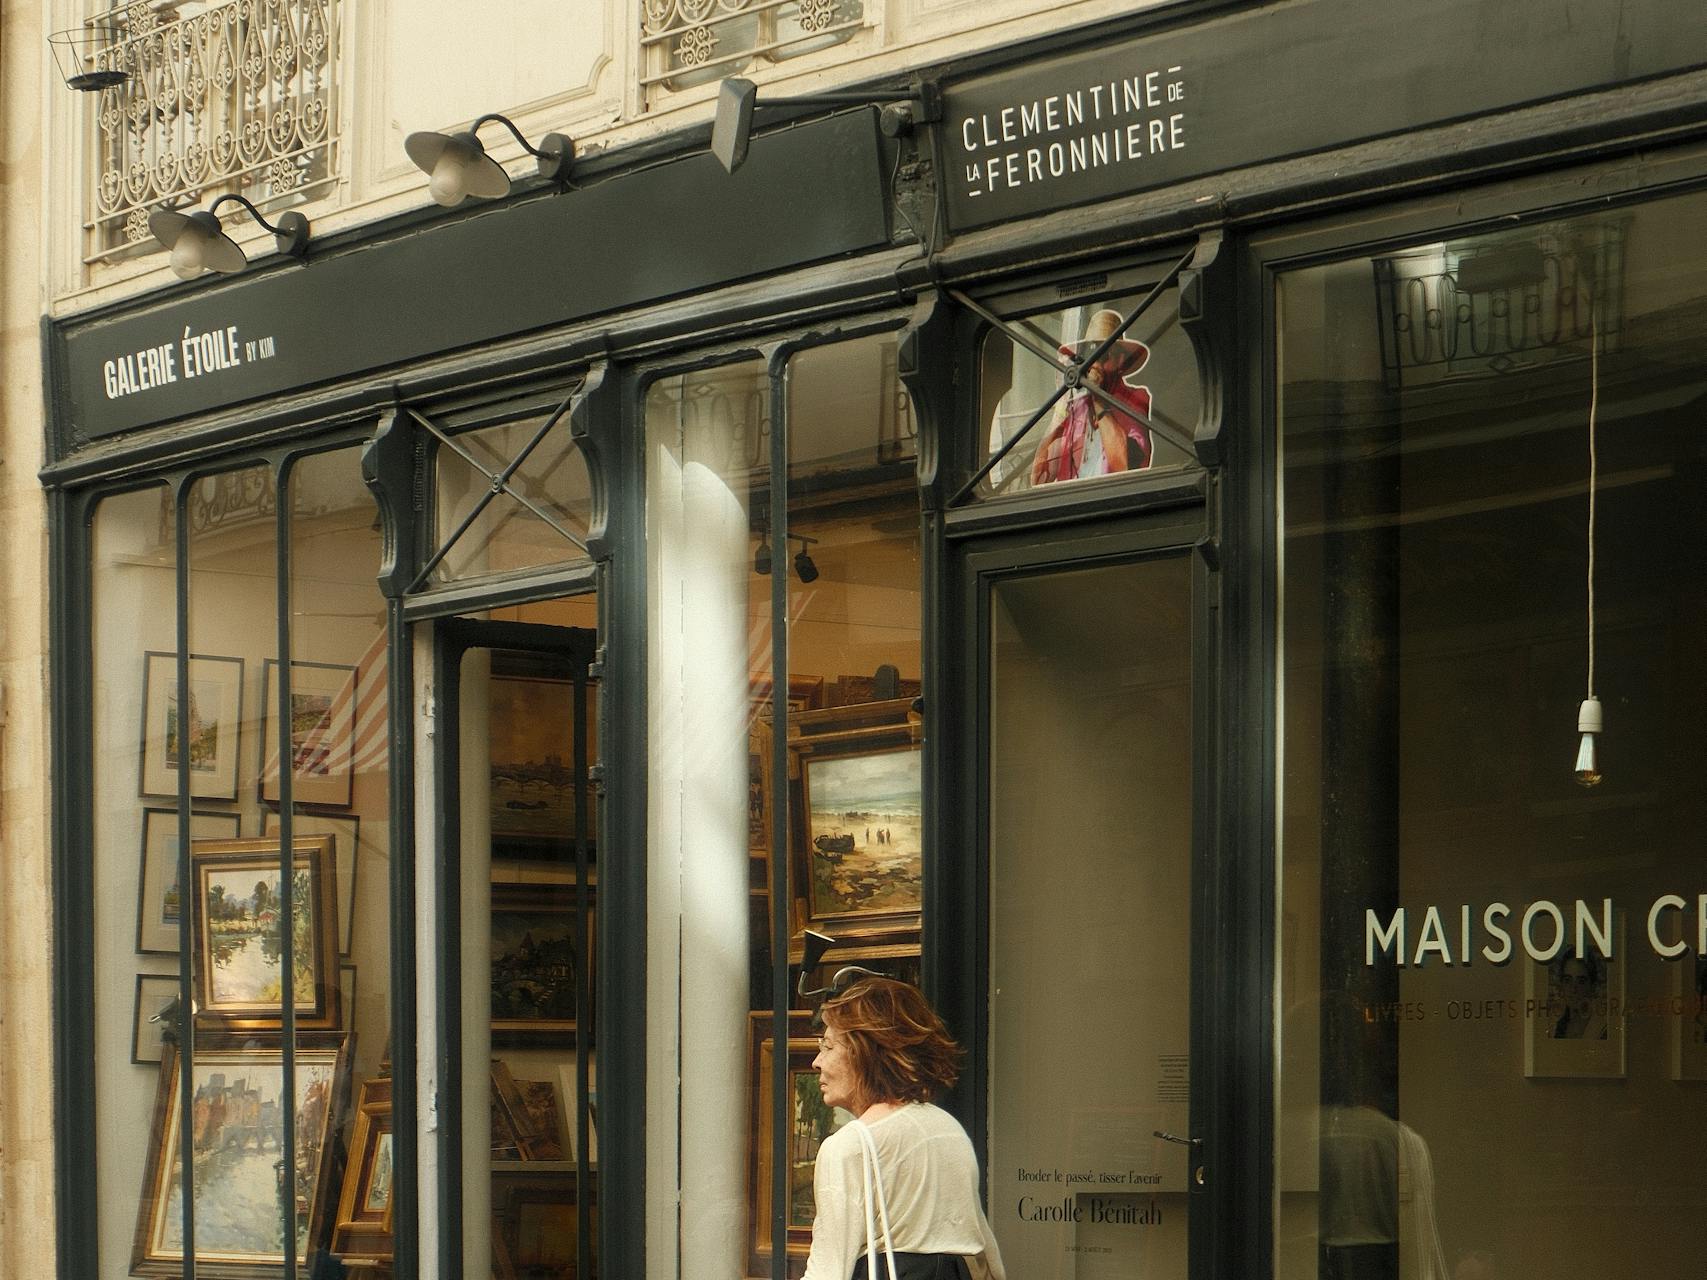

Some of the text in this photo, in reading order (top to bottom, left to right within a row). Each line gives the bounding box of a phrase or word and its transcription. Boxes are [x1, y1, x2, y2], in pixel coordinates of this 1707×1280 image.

[962, 71, 1184, 152] CLEMENTINE DE
[966, 113, 1185, 192] LA FERONNIERE
[103, 325, 276, 400] GALERIE ÉTOILE BY KIM
[1365, 897, 1614, 967] MAISON
[1447, 999, 1517, 1020] OBJETS
[1018, 1168, 1052, 1183] Broder
[1054, 1168, 1064, 1183] le
[1099, 1171, 1126, 1184] tisser
[1129, 1170, 1163, 1185] l'avenir
[1018, 1196, 1162, 1225] Carolle Bénitah
